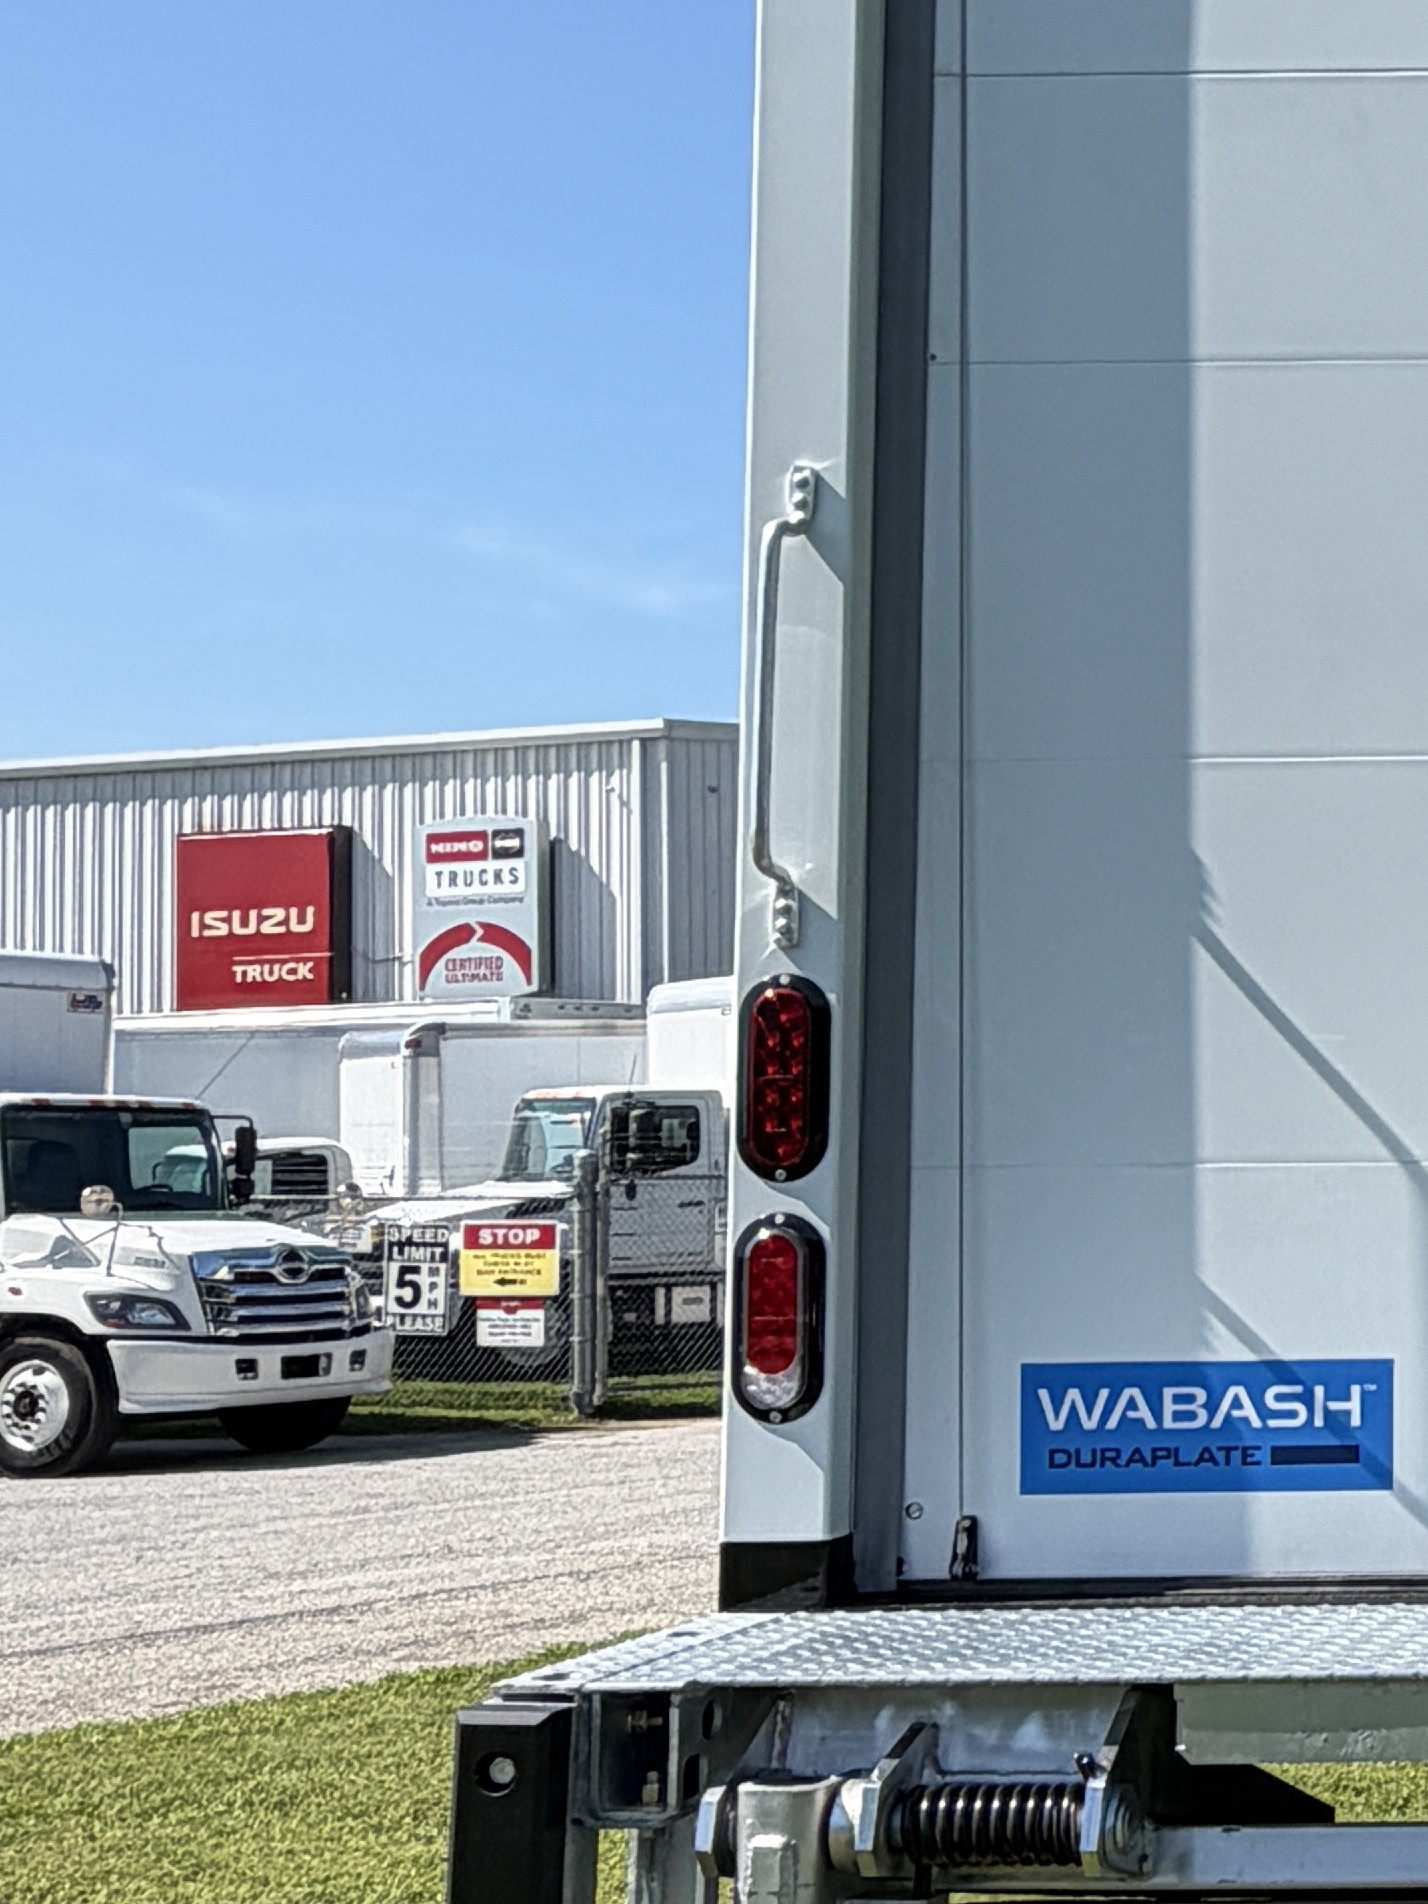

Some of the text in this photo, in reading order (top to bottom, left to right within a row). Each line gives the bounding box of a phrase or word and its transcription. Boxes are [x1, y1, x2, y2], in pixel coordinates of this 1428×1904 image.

[434, 866, 520, 889] TRUCKS
[190, 905, 316, 938] ISUZU
[231, 961, 315, 984] TRUCK
[387, 1228, 449, 1243] SPEED
[478, 1227, 541, 1246] STOP
[392, 1246, 444, 1261] LIMIT
[394, 1264, 422, 1310] 5
[386, 1314, 444, 1333] PLEASE
[1047, 1445, 1263, 1470] DURAPLATE
